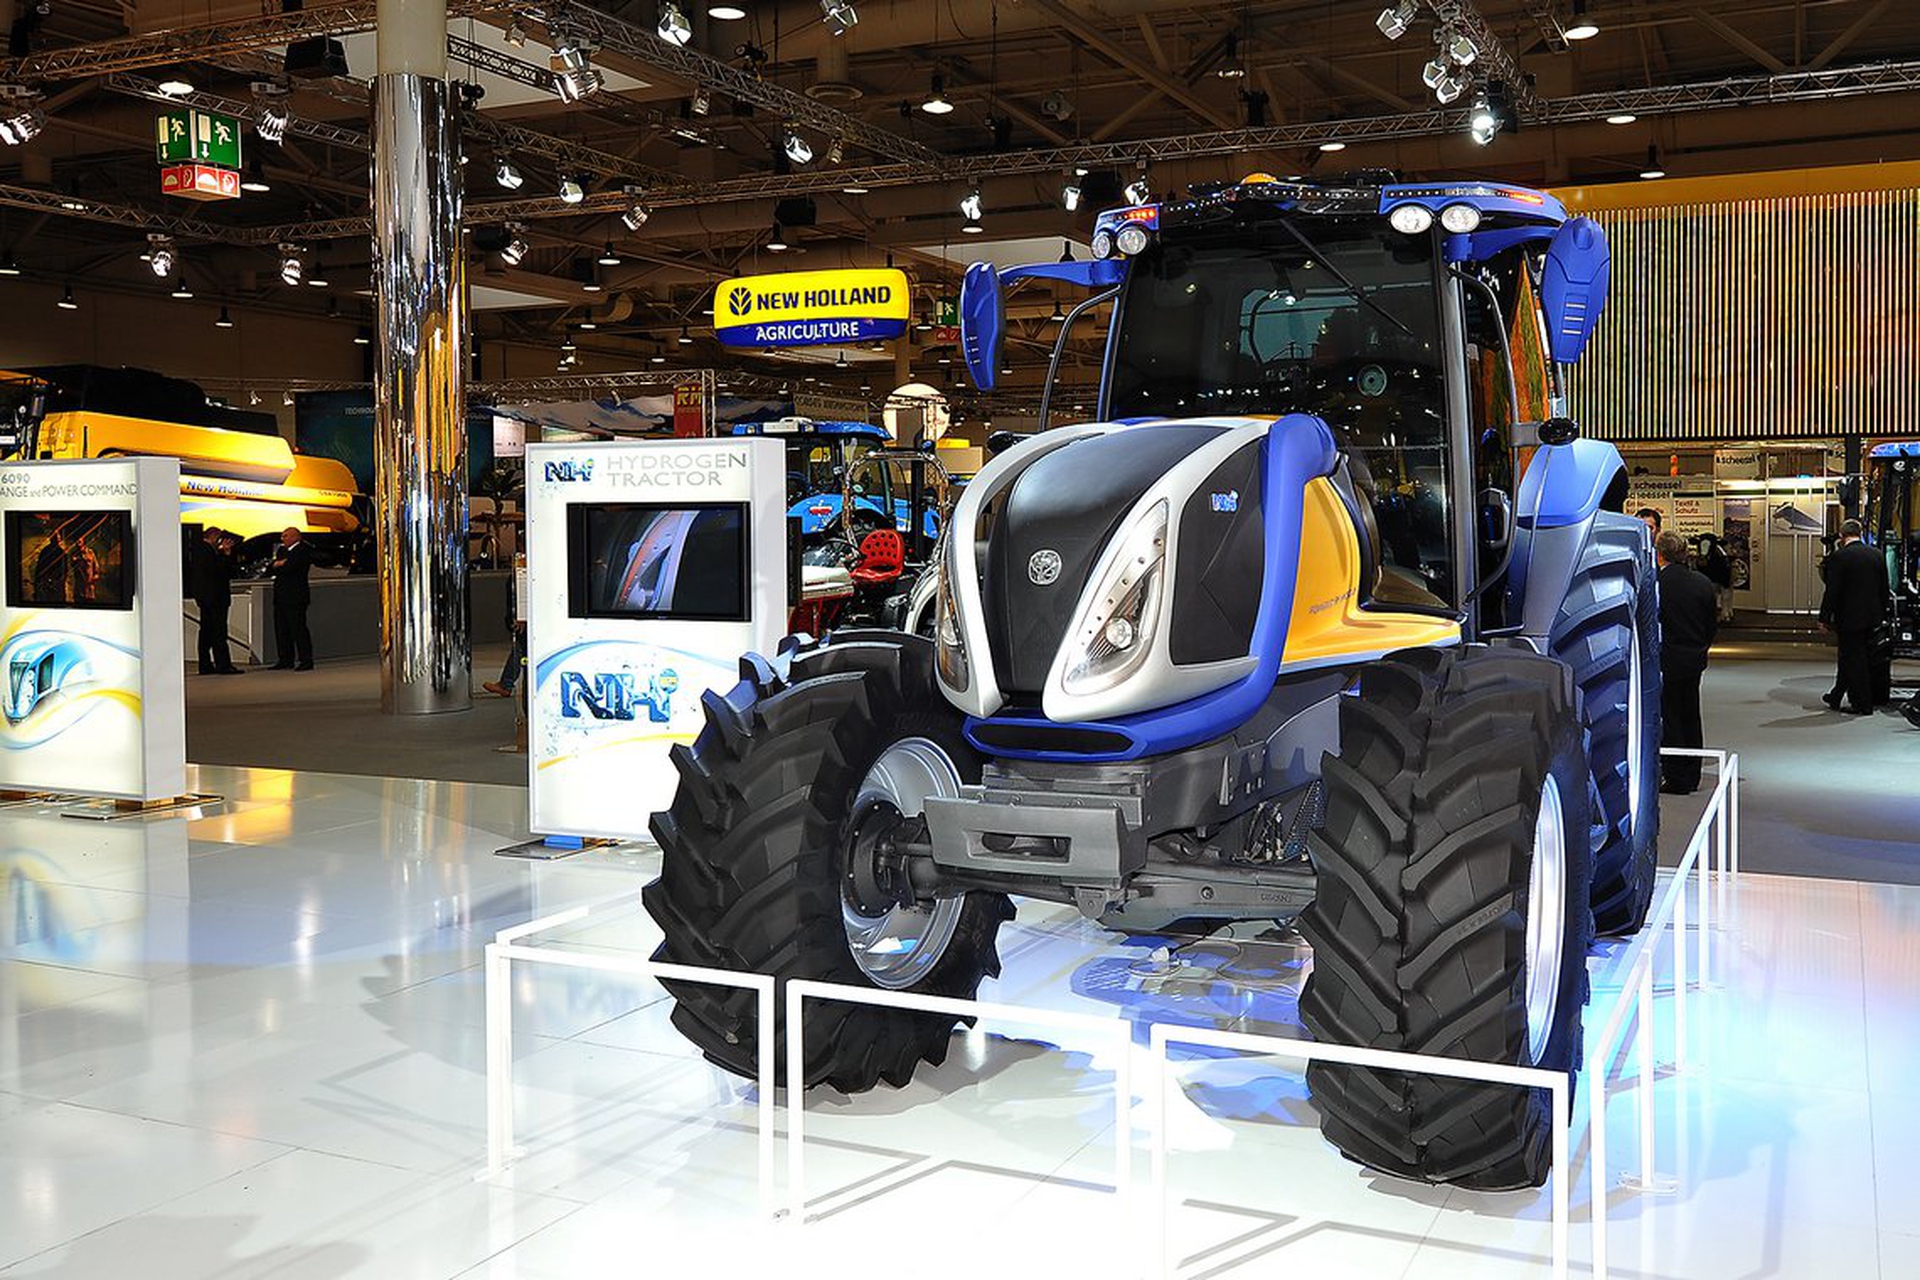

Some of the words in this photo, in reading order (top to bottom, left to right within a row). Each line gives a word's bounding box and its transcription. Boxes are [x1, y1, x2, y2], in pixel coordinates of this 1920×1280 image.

[757, 291, 800, 312] NEW
[804, 286, 892, 309] HOLLAND
[756, 322, 860, 342] AGRICULTURE
[607, 453, 747, 471] HYDROGEN
[1, 473, 31, 484] 6090
[607, 471, 723, 487] TRACTOR
[41, 484, 79, 498] POWER
[80, 482, 139, 497] COMMAND
